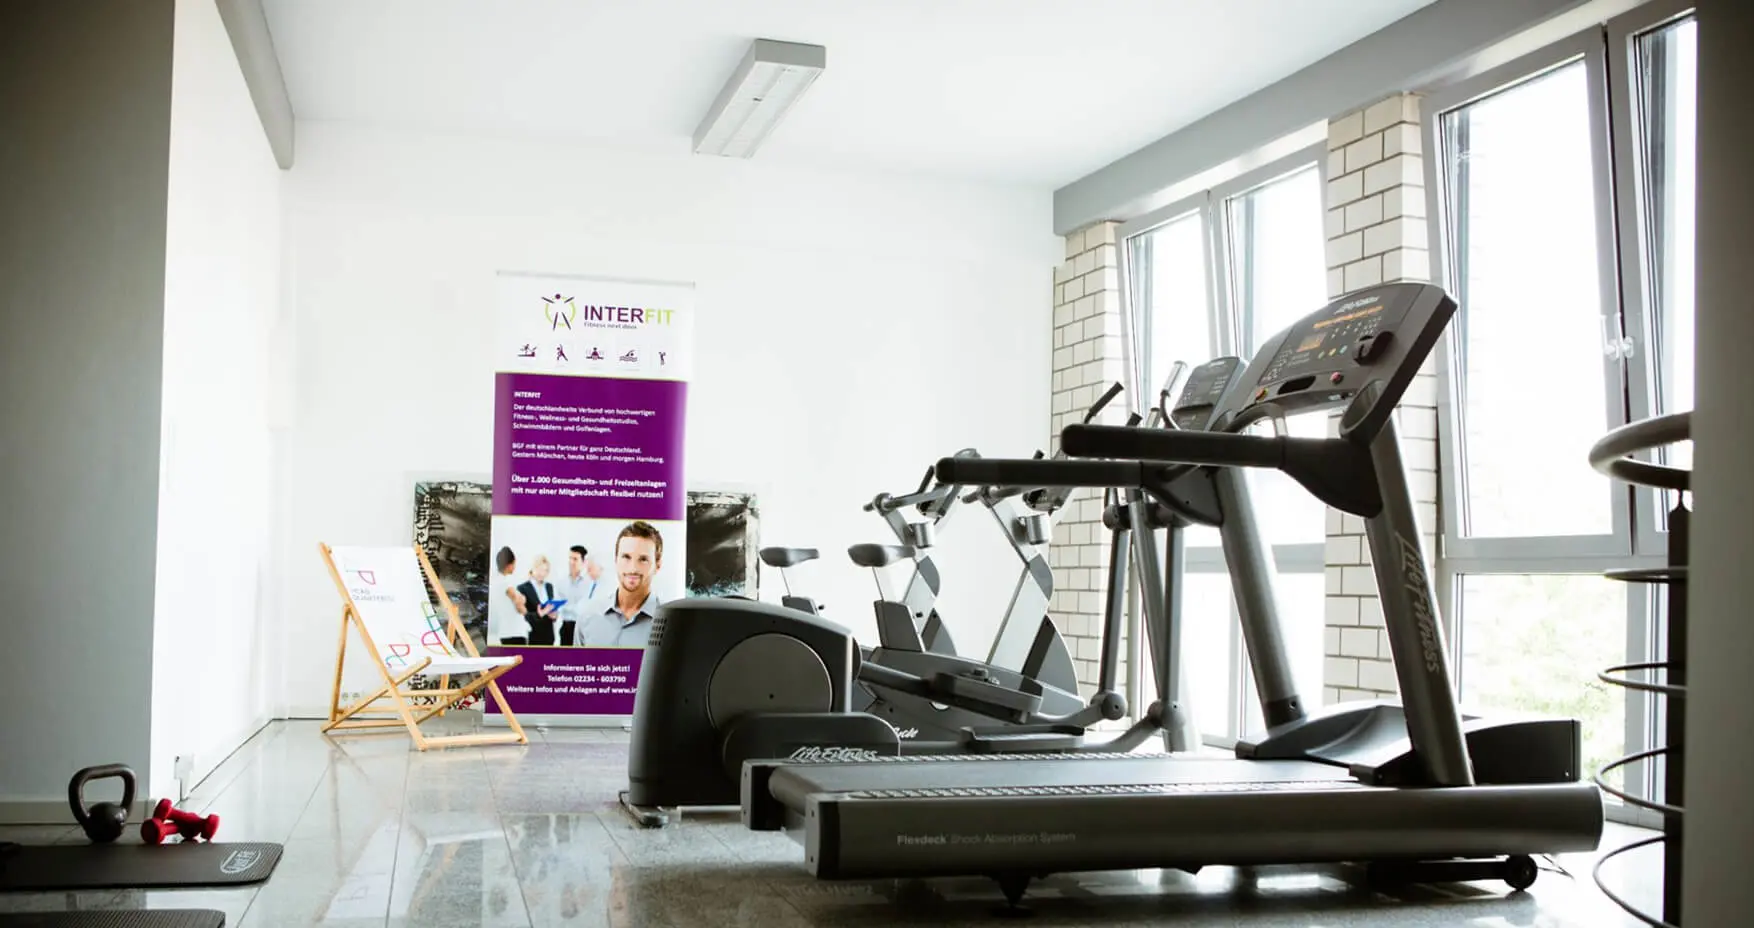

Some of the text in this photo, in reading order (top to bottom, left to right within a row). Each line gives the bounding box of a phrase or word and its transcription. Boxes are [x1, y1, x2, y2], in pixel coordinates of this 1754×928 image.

[584, 305, 675, 326] INTERFIT
[514, 391, 541, 399] INTERFIT
[513, 403, 525, 411] Der
[526, 404, 577, 413] deutschlandweite
[578, 406, 603, 414] Verbund
[616, 408, 656, 417] hochwertigen
[513, 422, 562, 431] Schwimmbädern
[537, 451, 566, 460] München,
[586, 453, 599, 461] Köln
[636, 456, 664, 464] Hamburg.
[511, 474, 667, 489] Über 1.000 Gesundheits- und Freizeitanlagen
[511, 486, 524, 494] mit
[538, 487, 557, 495] einer
[558, 488, 609, 497] Mitgliedschaft
[610, 489, 636, 498] flexibel
[636, 490, 664, 499] nutzen!
[543, 664, 631, 673] Informieren Sie sich jetzt!
[547, 675, 573, 683] Telefon
[574, 675, 595, 683] 02234
[506, 685, 534, 693] Weitere
[535, 685, 553, 693] Infos
[569, 686, 598, 695] Anlagen
[984, 832, 1038, 846] Absorption
[1039, 830, 1077, 846] System
